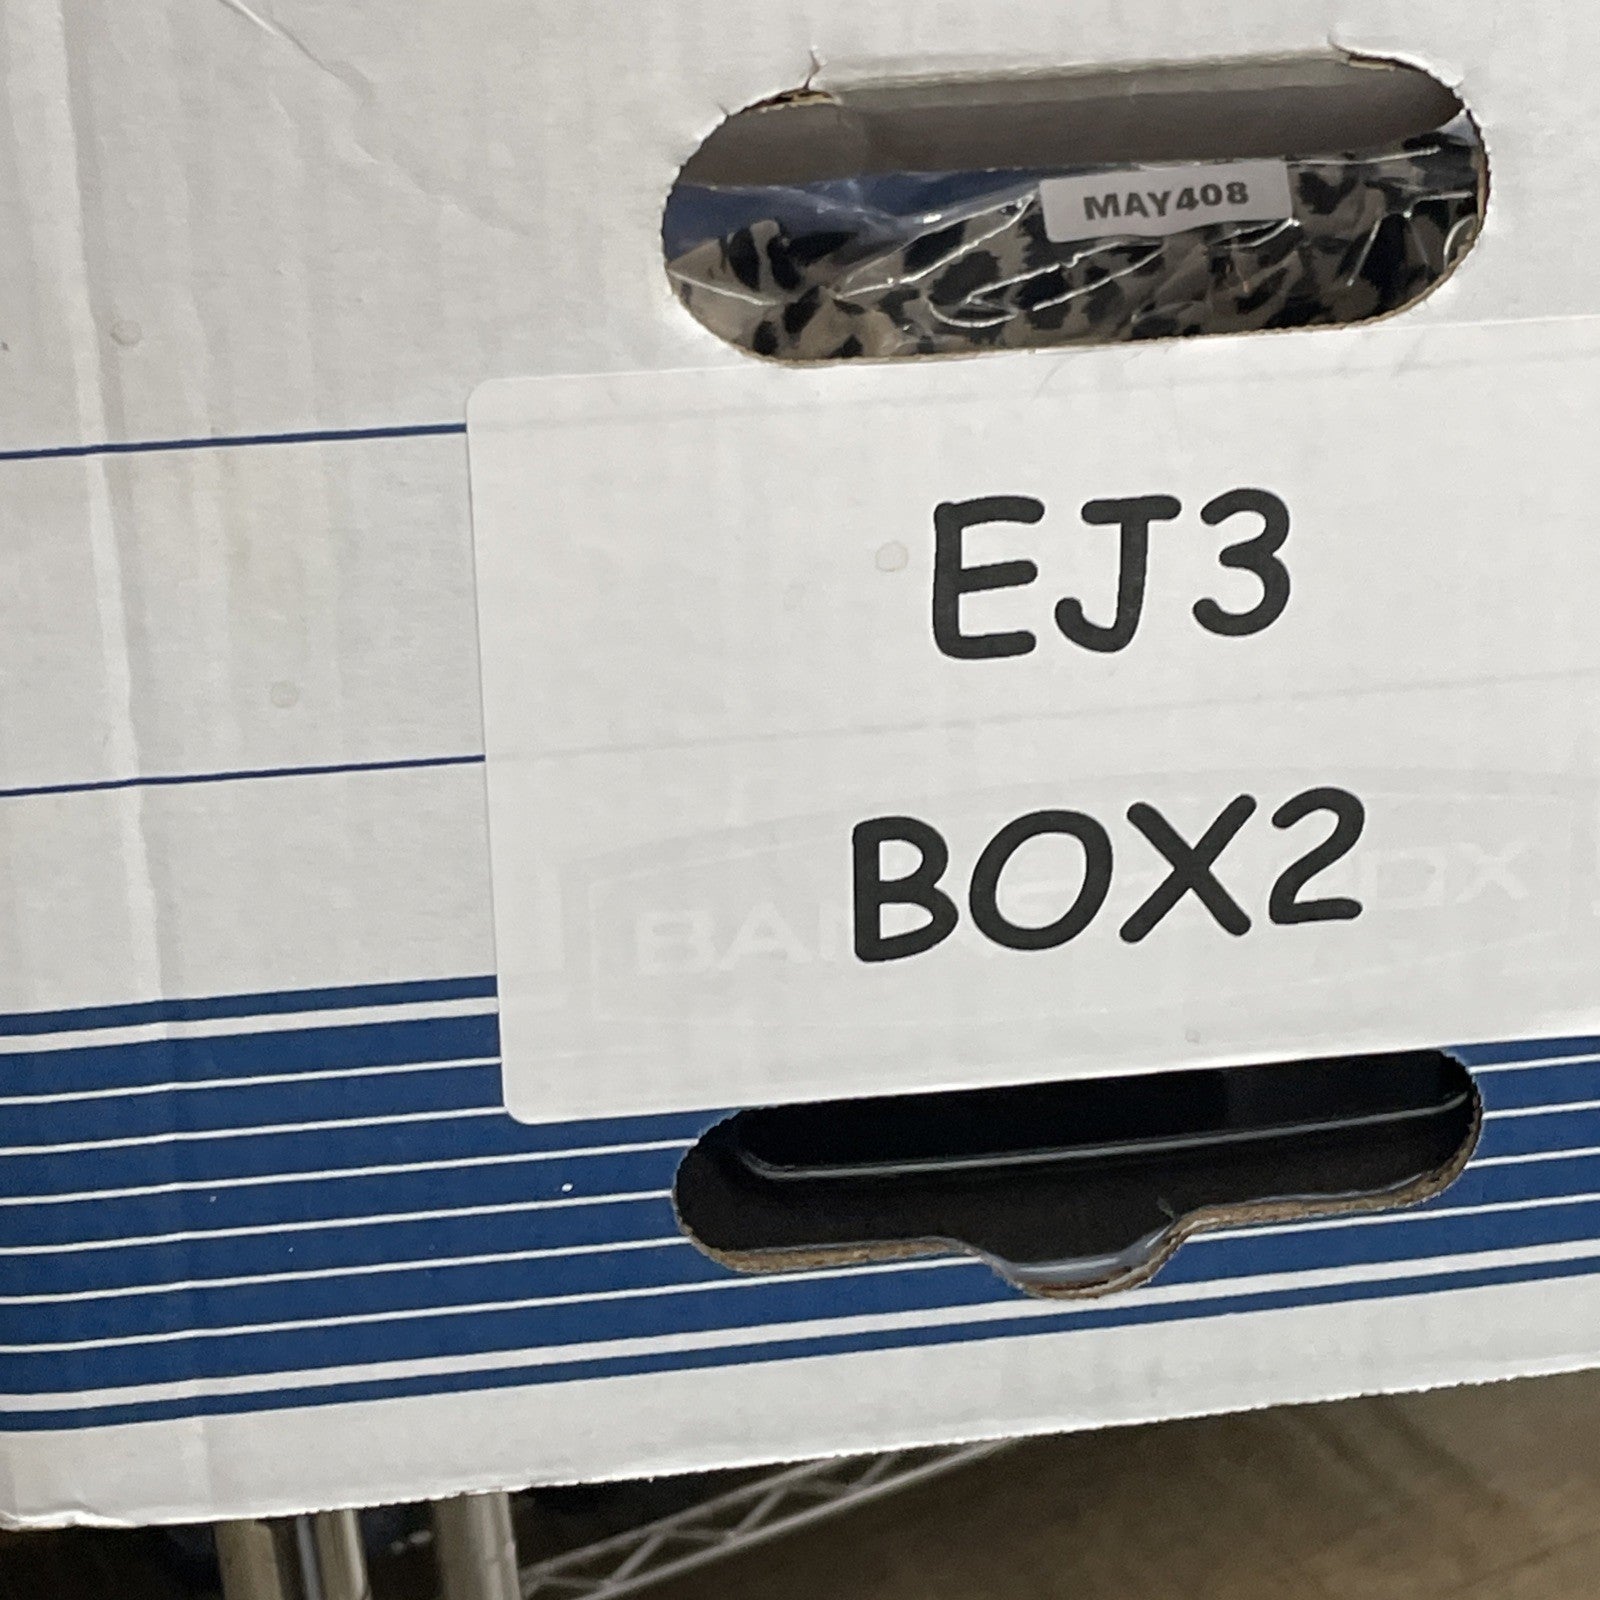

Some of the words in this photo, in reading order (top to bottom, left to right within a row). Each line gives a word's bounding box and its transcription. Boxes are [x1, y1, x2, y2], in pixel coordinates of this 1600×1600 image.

[1083, 181, 1250, 221] MAY408
[932, 487, 1291, 660] EJ3
[851, 786, 1364, 962] BOX2
